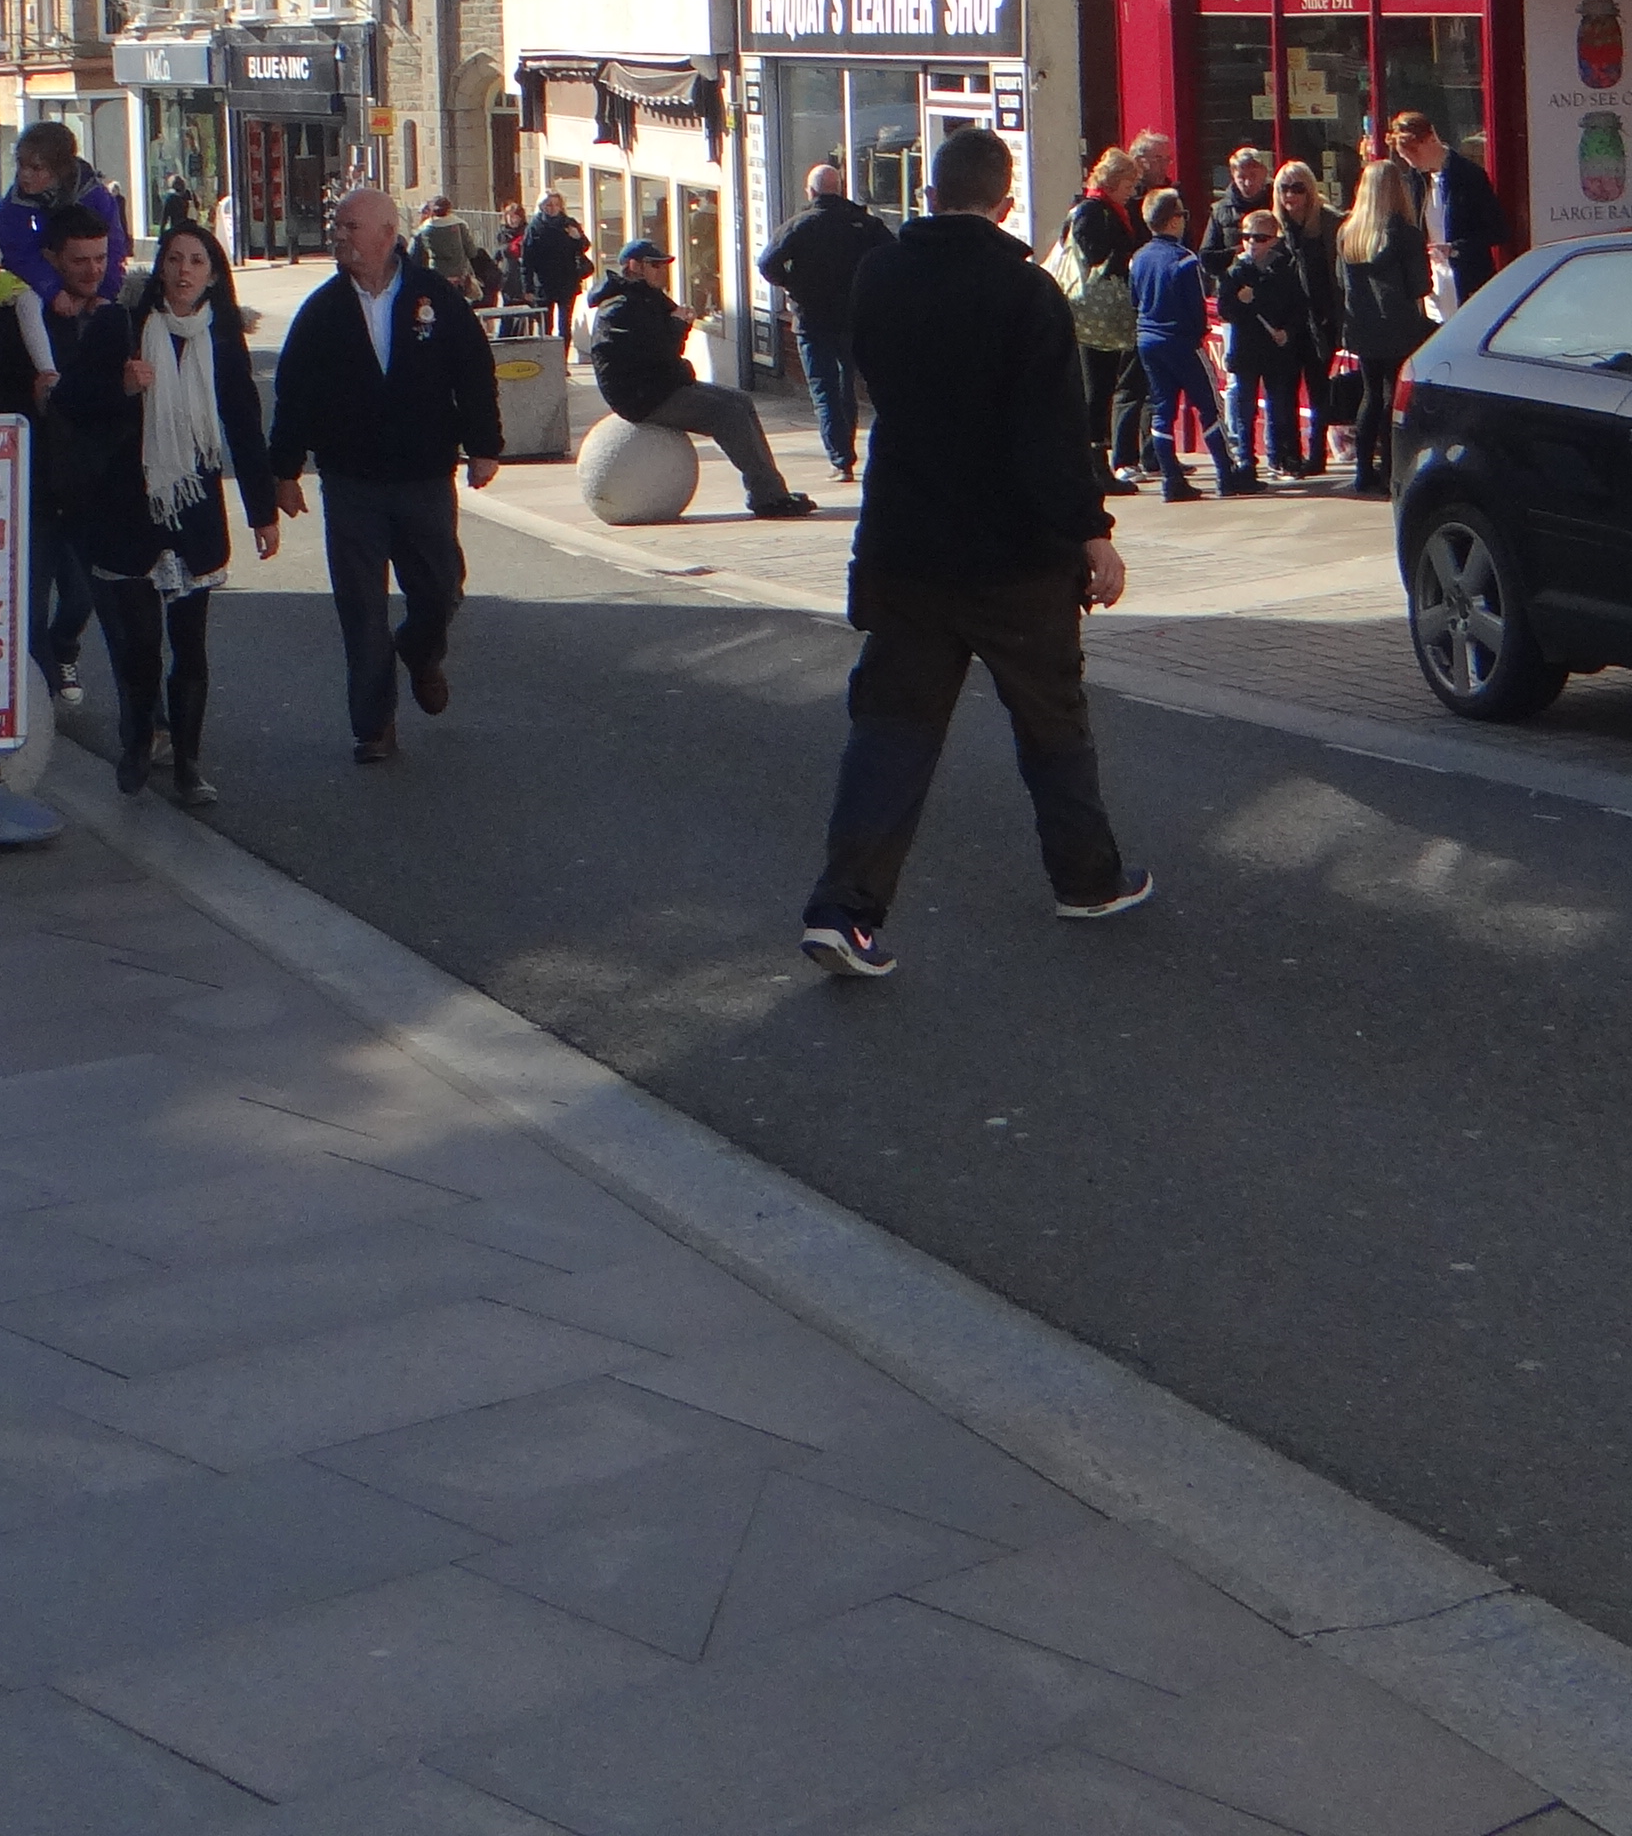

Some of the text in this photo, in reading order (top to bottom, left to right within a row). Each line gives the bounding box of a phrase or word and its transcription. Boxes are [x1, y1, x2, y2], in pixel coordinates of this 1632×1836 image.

[248, 56, 310, 80] BLUE INC
[1548, 92, 1585, 108] AND
[1589, 92, 1619, 107] SEE
[1550, 204, 1604, 222] LARGE
